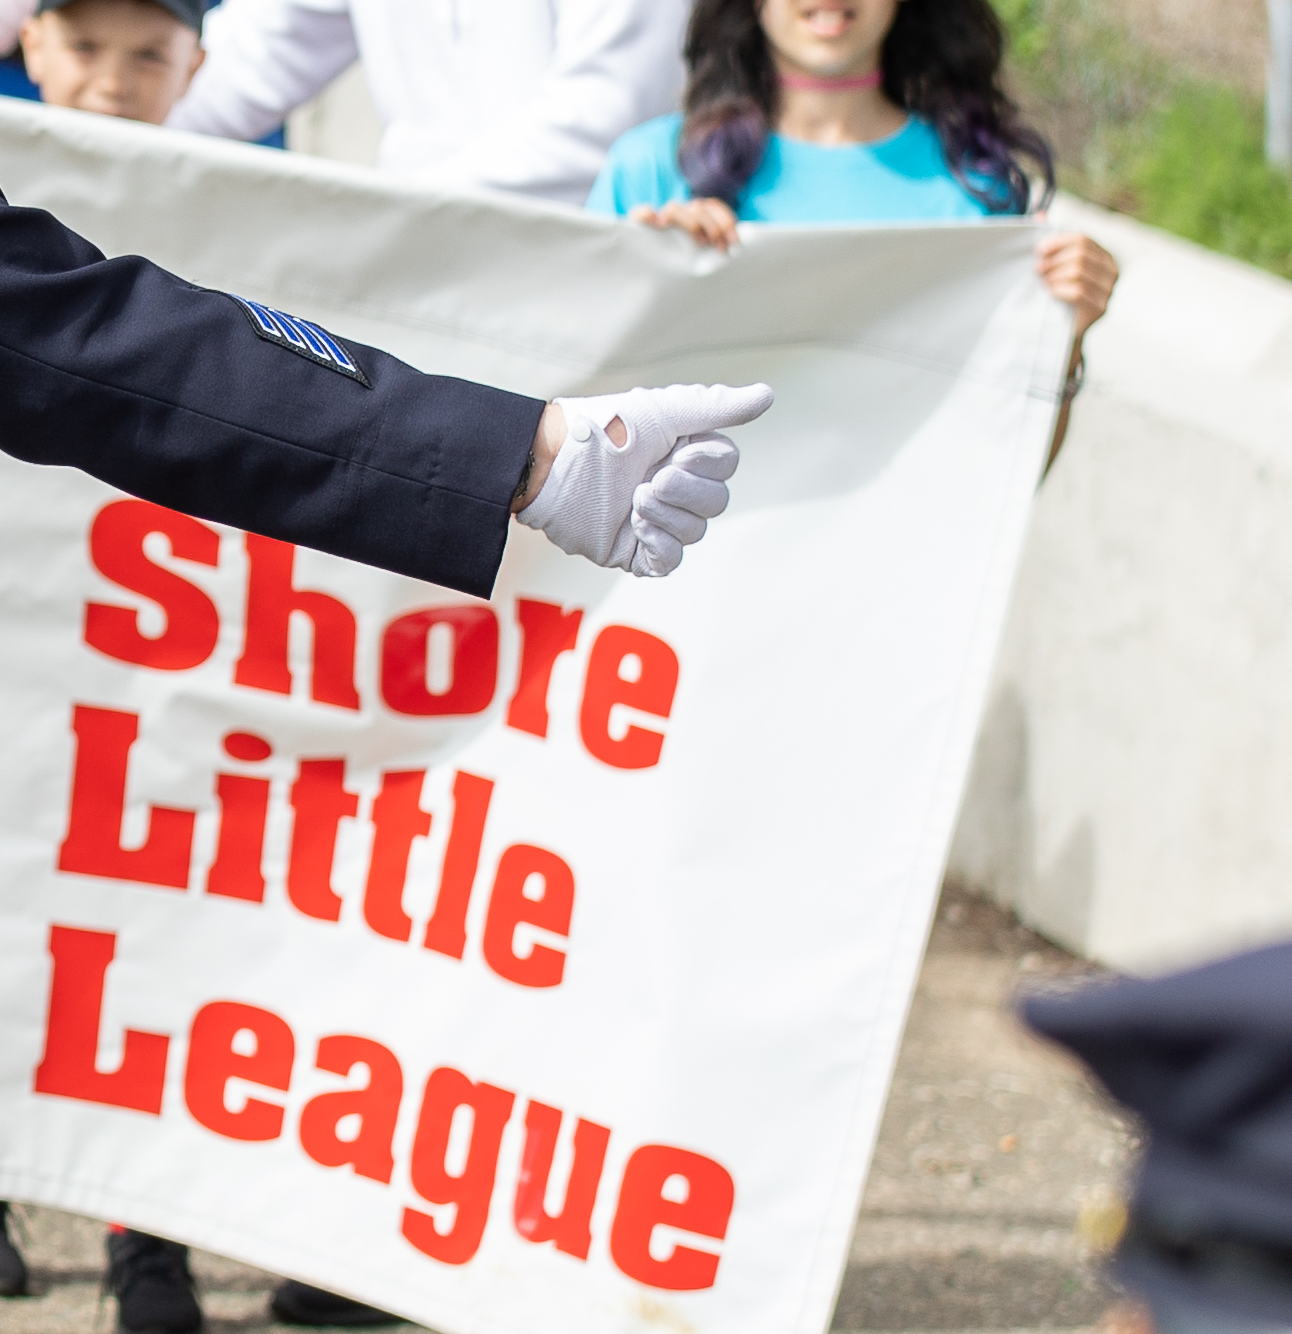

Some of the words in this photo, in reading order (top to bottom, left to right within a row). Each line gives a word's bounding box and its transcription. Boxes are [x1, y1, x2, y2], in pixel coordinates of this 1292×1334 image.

[84, 499, 680, 770] Shore
[57, 704, 576, 988] Little
[34, 925, 735, 1292] League
